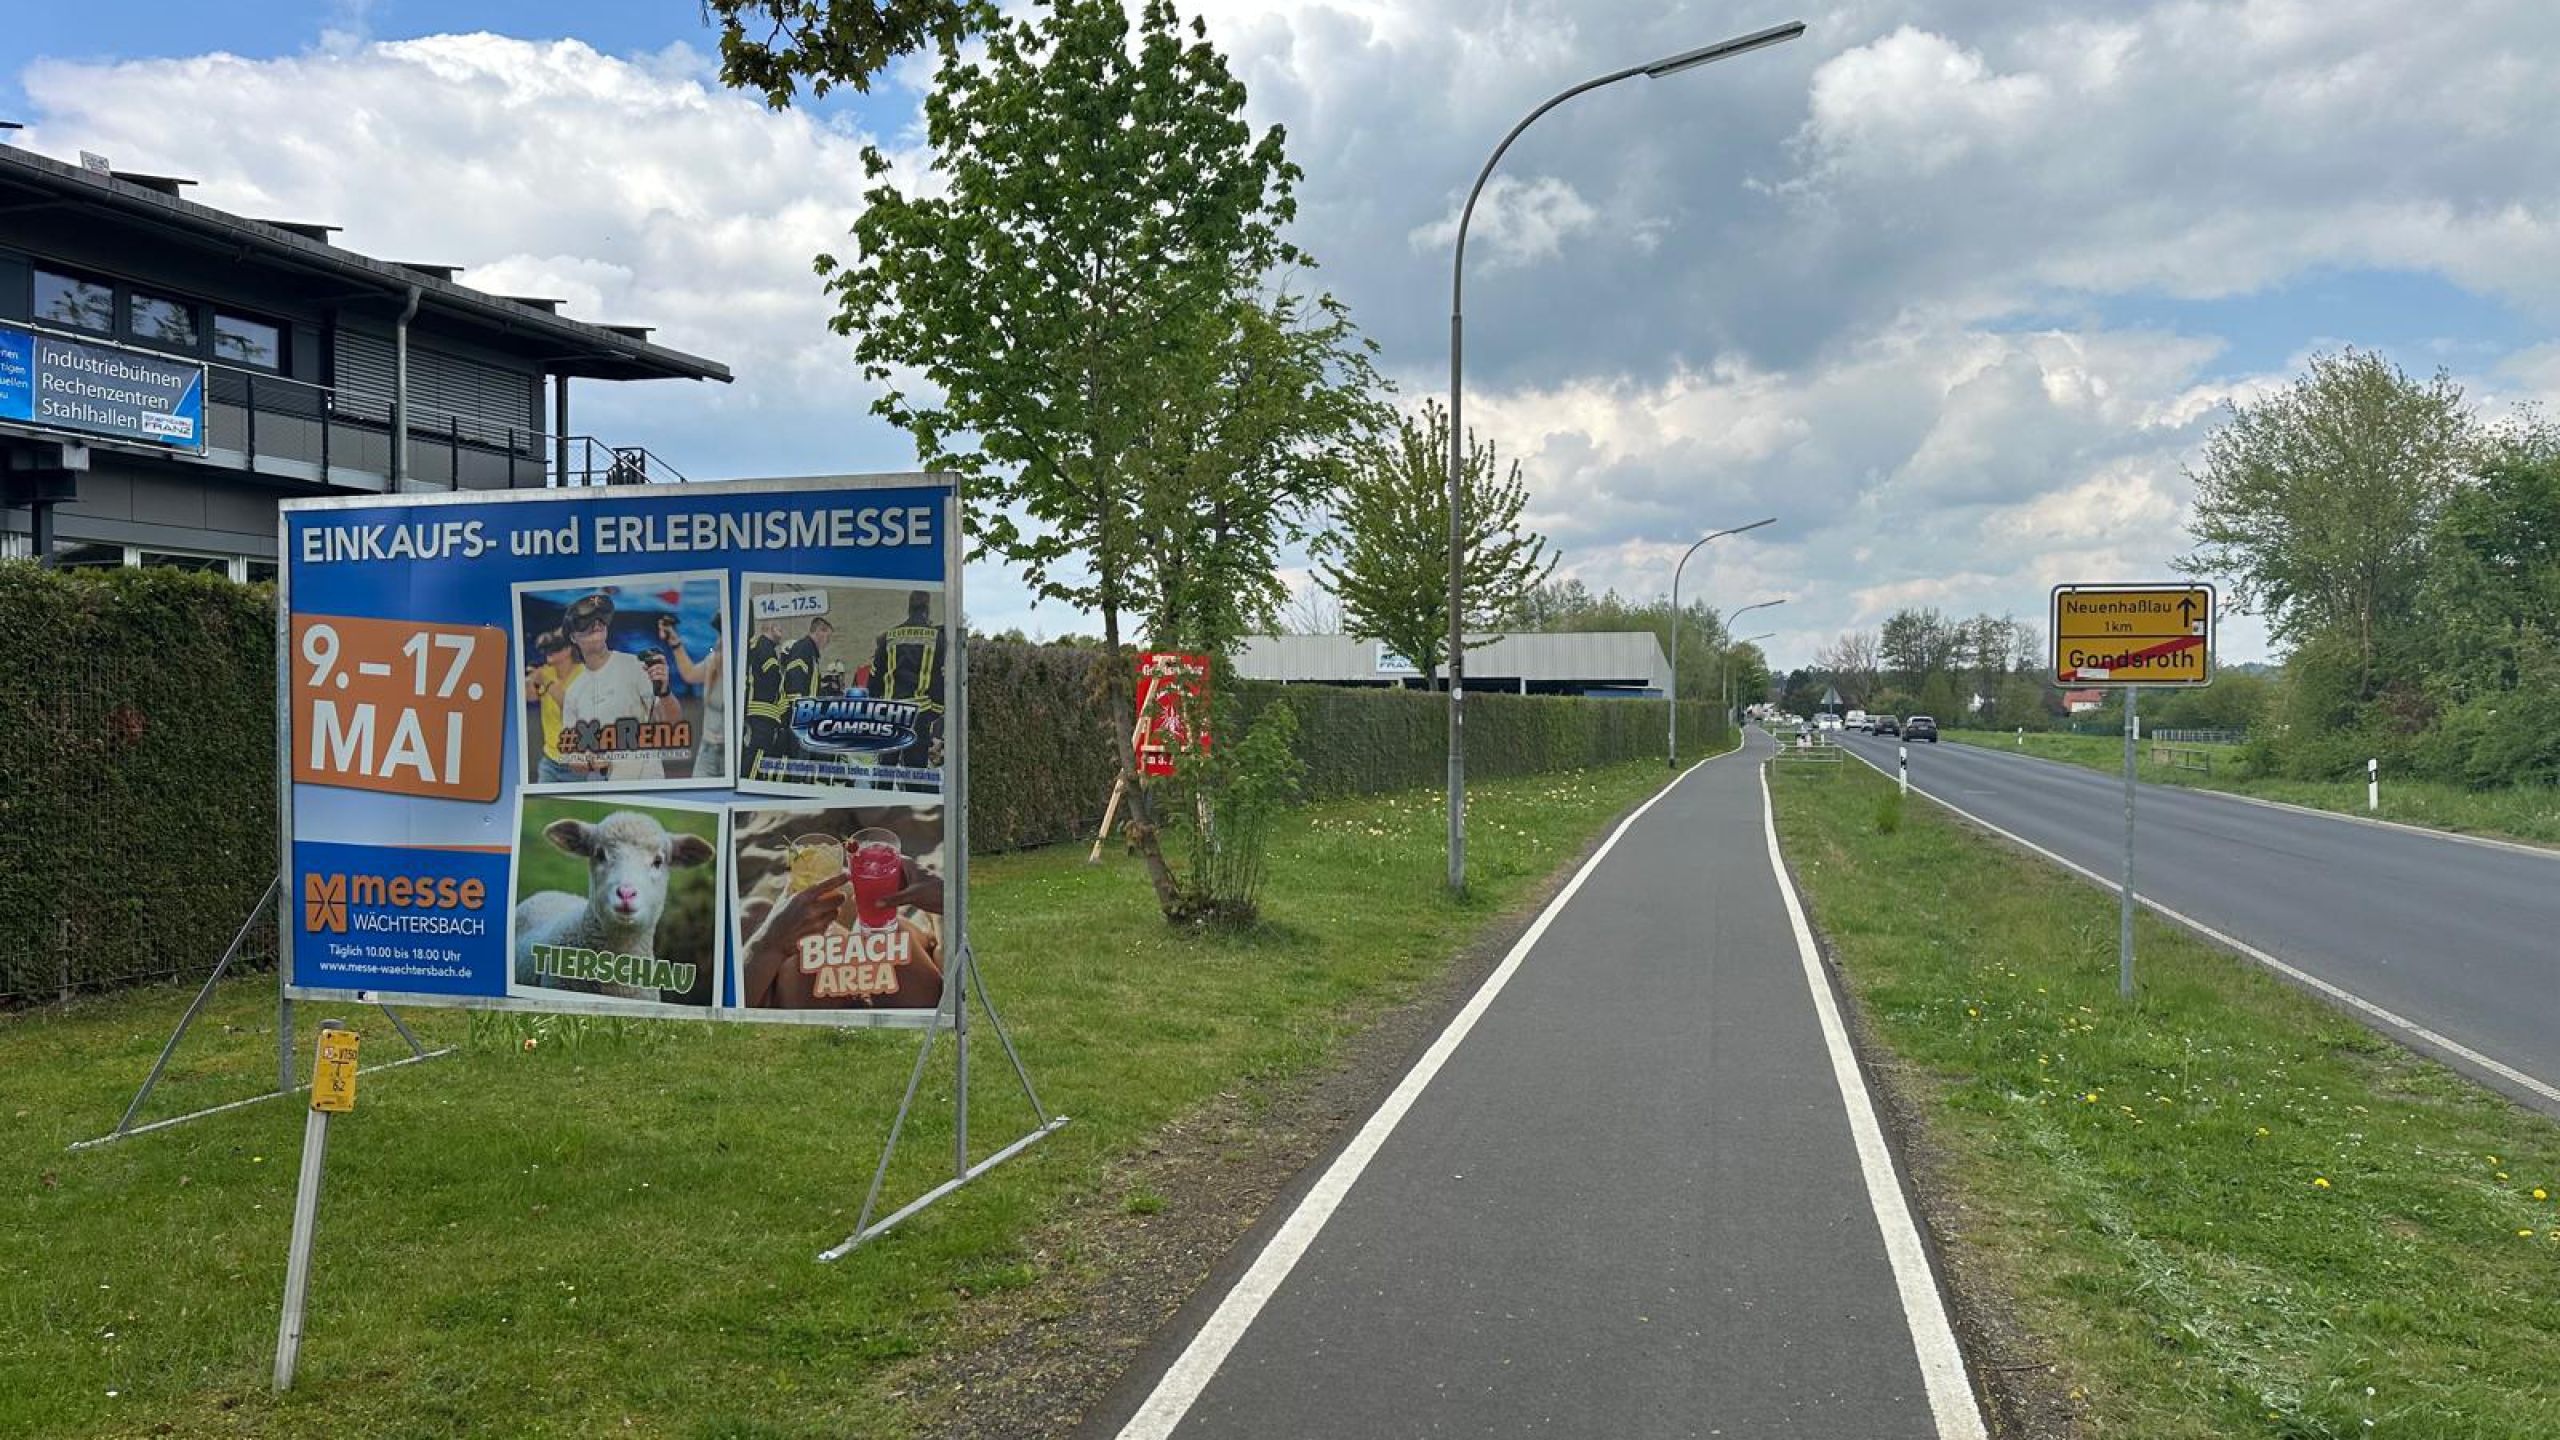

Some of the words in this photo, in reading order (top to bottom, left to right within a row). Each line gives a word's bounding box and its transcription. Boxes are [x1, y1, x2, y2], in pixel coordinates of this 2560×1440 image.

[42, 346, 182, 389] Industriebühnen
[42, 372, 170, 410] Rechenzentren
[42, 398, 137, 430] Stahlhallen
[302, 520, 497, 563] EINKAUFS-
[511, 516, 579, 556] und
[595, 506, 933, 553] ERLEBNISMESSE
[2066, 599, 2172, 614] Neuenhaßlau
[2069, 648, 2194, 668] Gondsroth
[795, 699, 917, 725] BLAULICHT
[816, 719, 894, 737] CAMPUS
[311, 699, 463, 785] MAI
[352, 875, 486, 910] messe
[353, 912, 485, 936] WÄCHTERSBACH
[328, 943, 363, 959] Täglich
[366, 946, 391, 958] 10.00
[394, 947, 409, 959] bis
[412, 948, 439, 961] 18.00
[442, 950, 462, 962] Uhr
[801, 930, 911, 972] BEACH
[319, 962, 473, 977] www.messe-waechtersbach.de
[531, 943, 697, 994] TIERSCHAU
[814, 964, 898, 996] AREA
